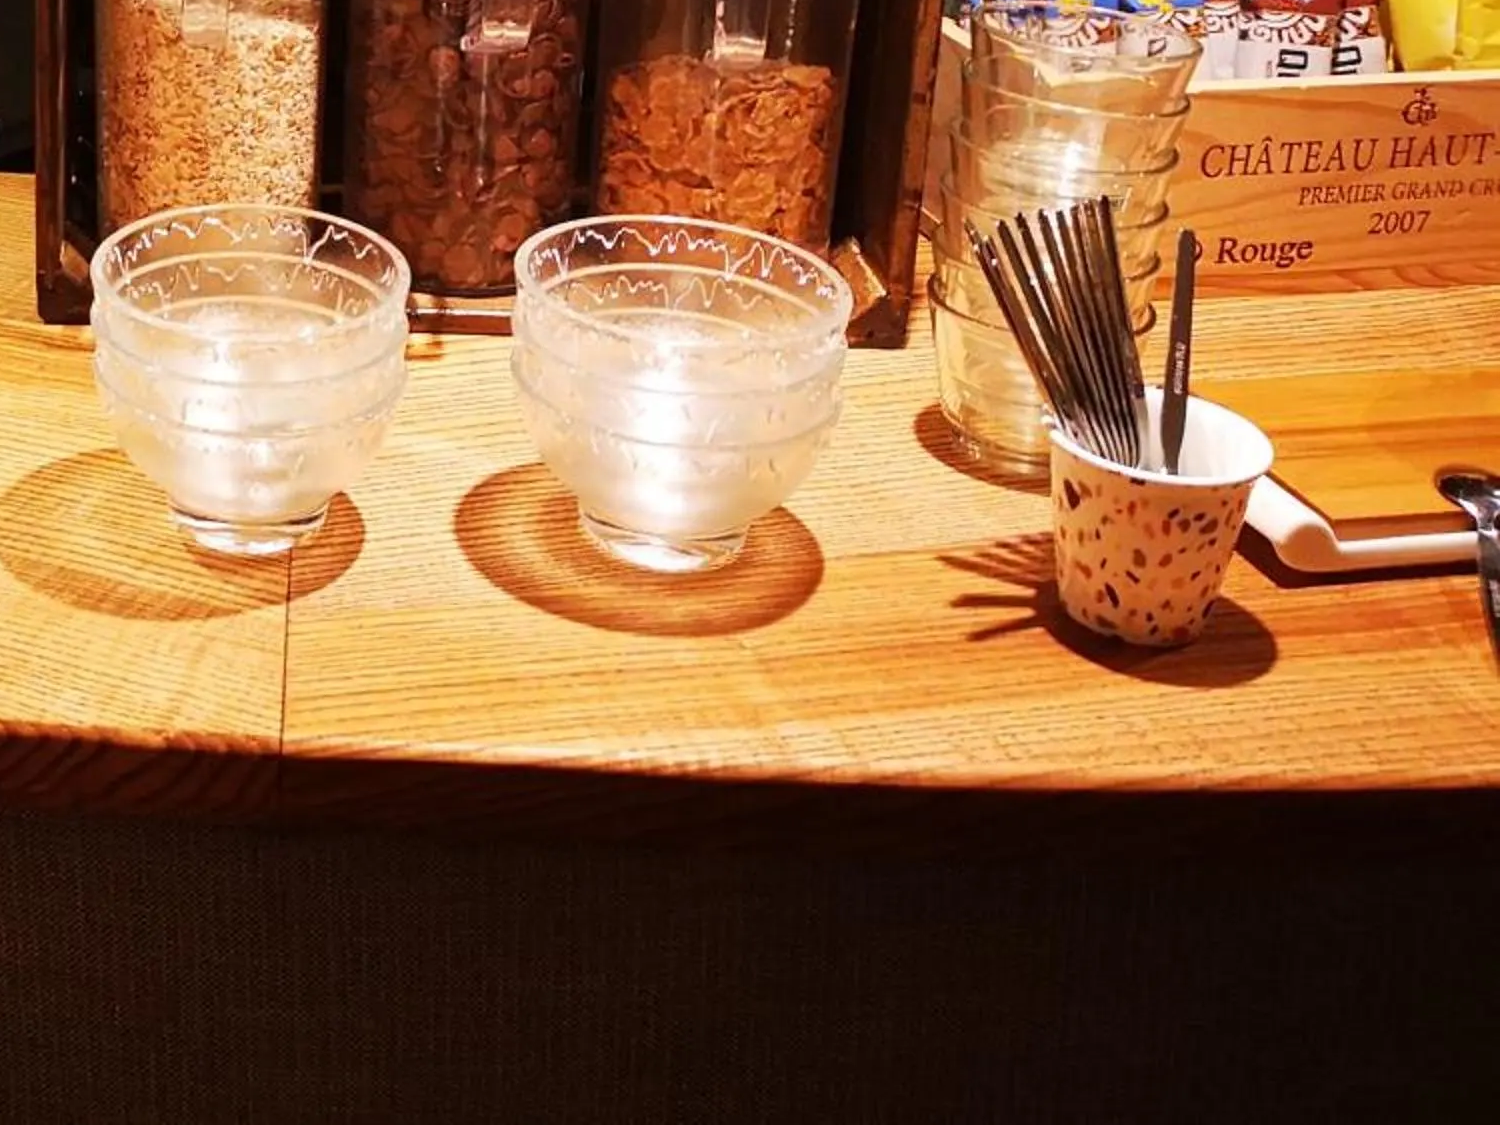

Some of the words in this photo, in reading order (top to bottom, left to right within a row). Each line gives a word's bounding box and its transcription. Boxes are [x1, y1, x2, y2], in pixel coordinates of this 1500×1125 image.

[1200, 135, 1379, 178] CHÂTEAU
[1298, 183, 1386, 206] PREMIER
[1391, 180, 1464, 201] GRAND
[1469, 178, 1500, 197] CR
[1367, 210, 1431, 235] 2007
[1214, 237, 1314, 268] Rouge
